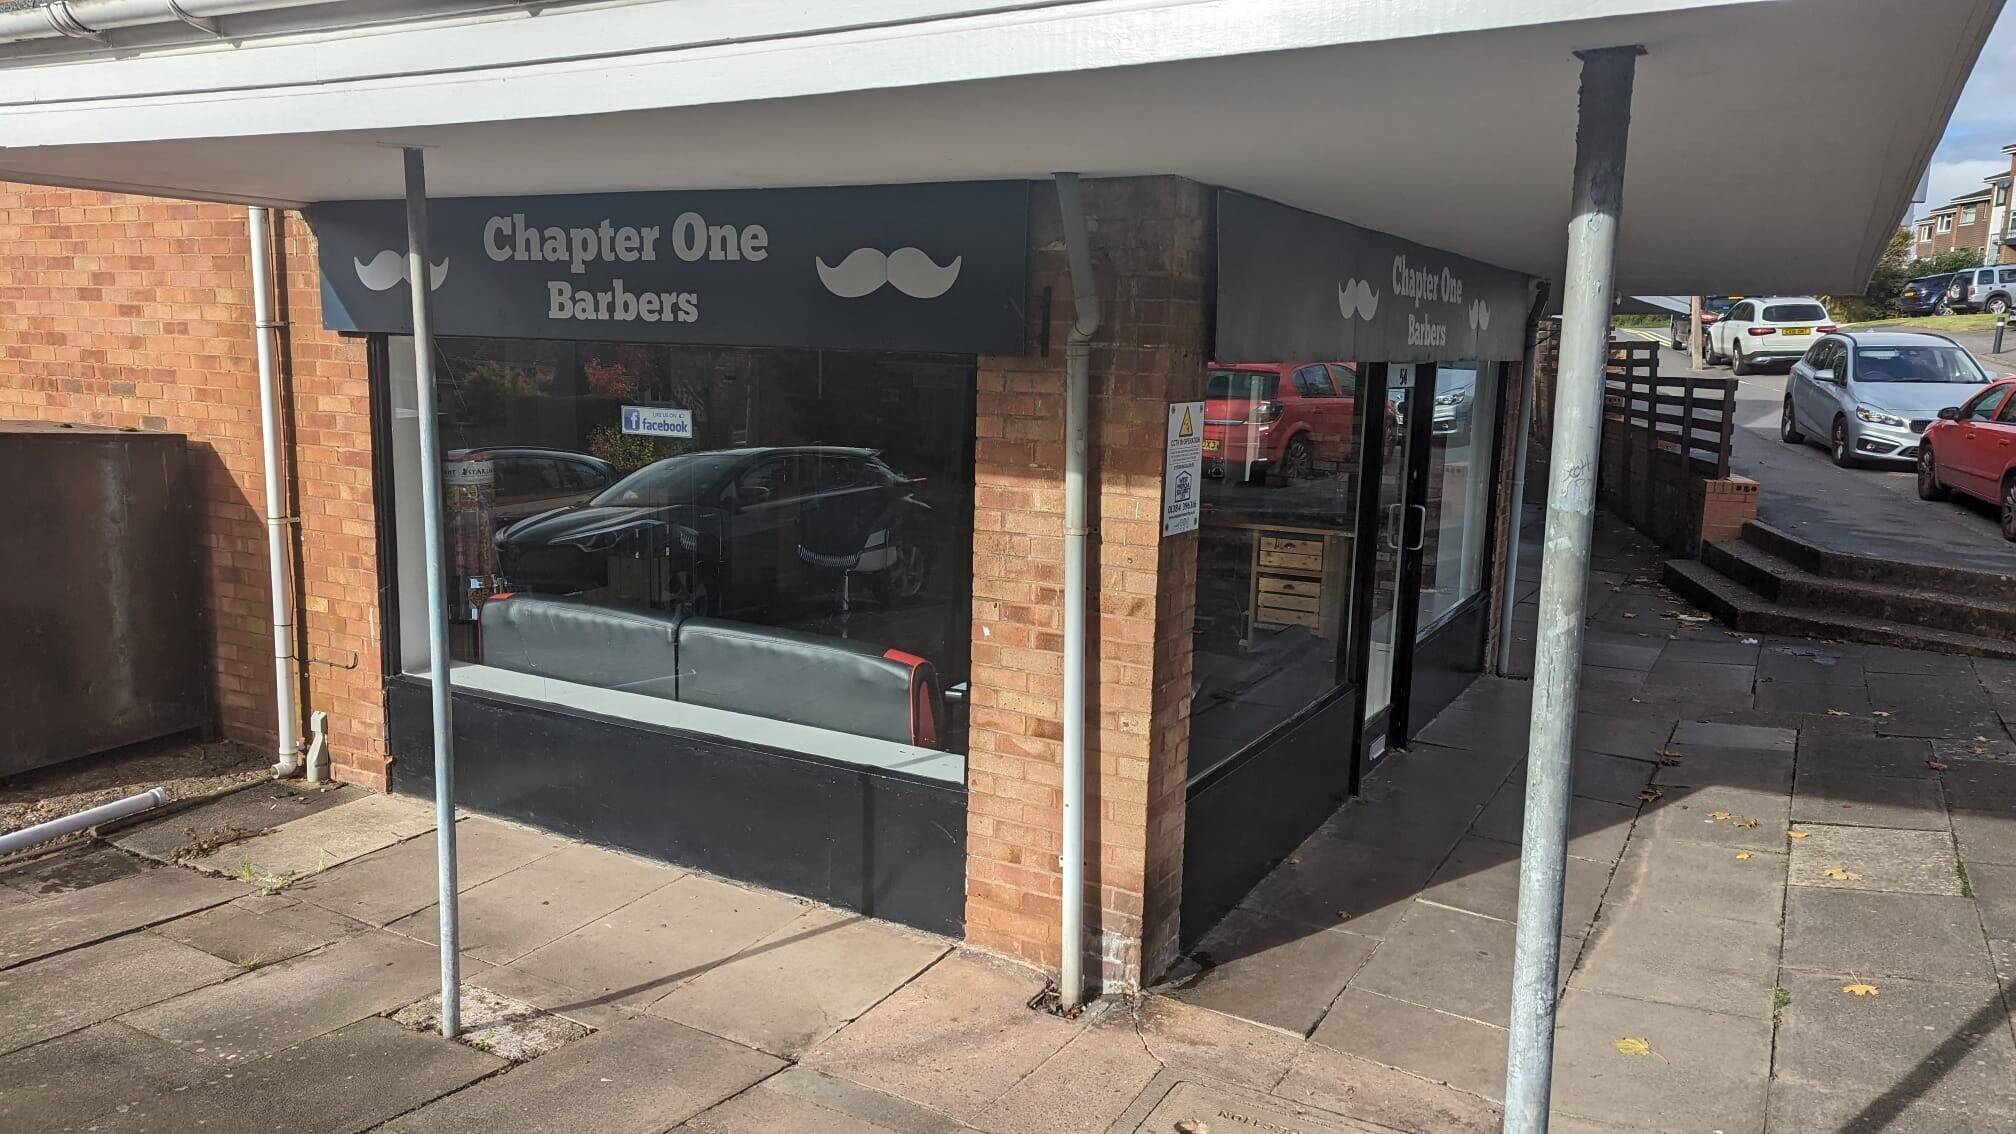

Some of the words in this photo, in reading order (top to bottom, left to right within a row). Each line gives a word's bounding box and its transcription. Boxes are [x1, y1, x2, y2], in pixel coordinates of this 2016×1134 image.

[483, 213, 660, 274] Chapter
[672, 211, 769, 262] One
[547, 278, 699, 323] Barbers
[1392, 254, 1439, 308] Chapter
[1441, 266, 1463, 304] One
[1407, 313, 1447, 346] Barbers
[642, 418, 688, 433] facebook
[1168, 503, 1181, 514] 01384
